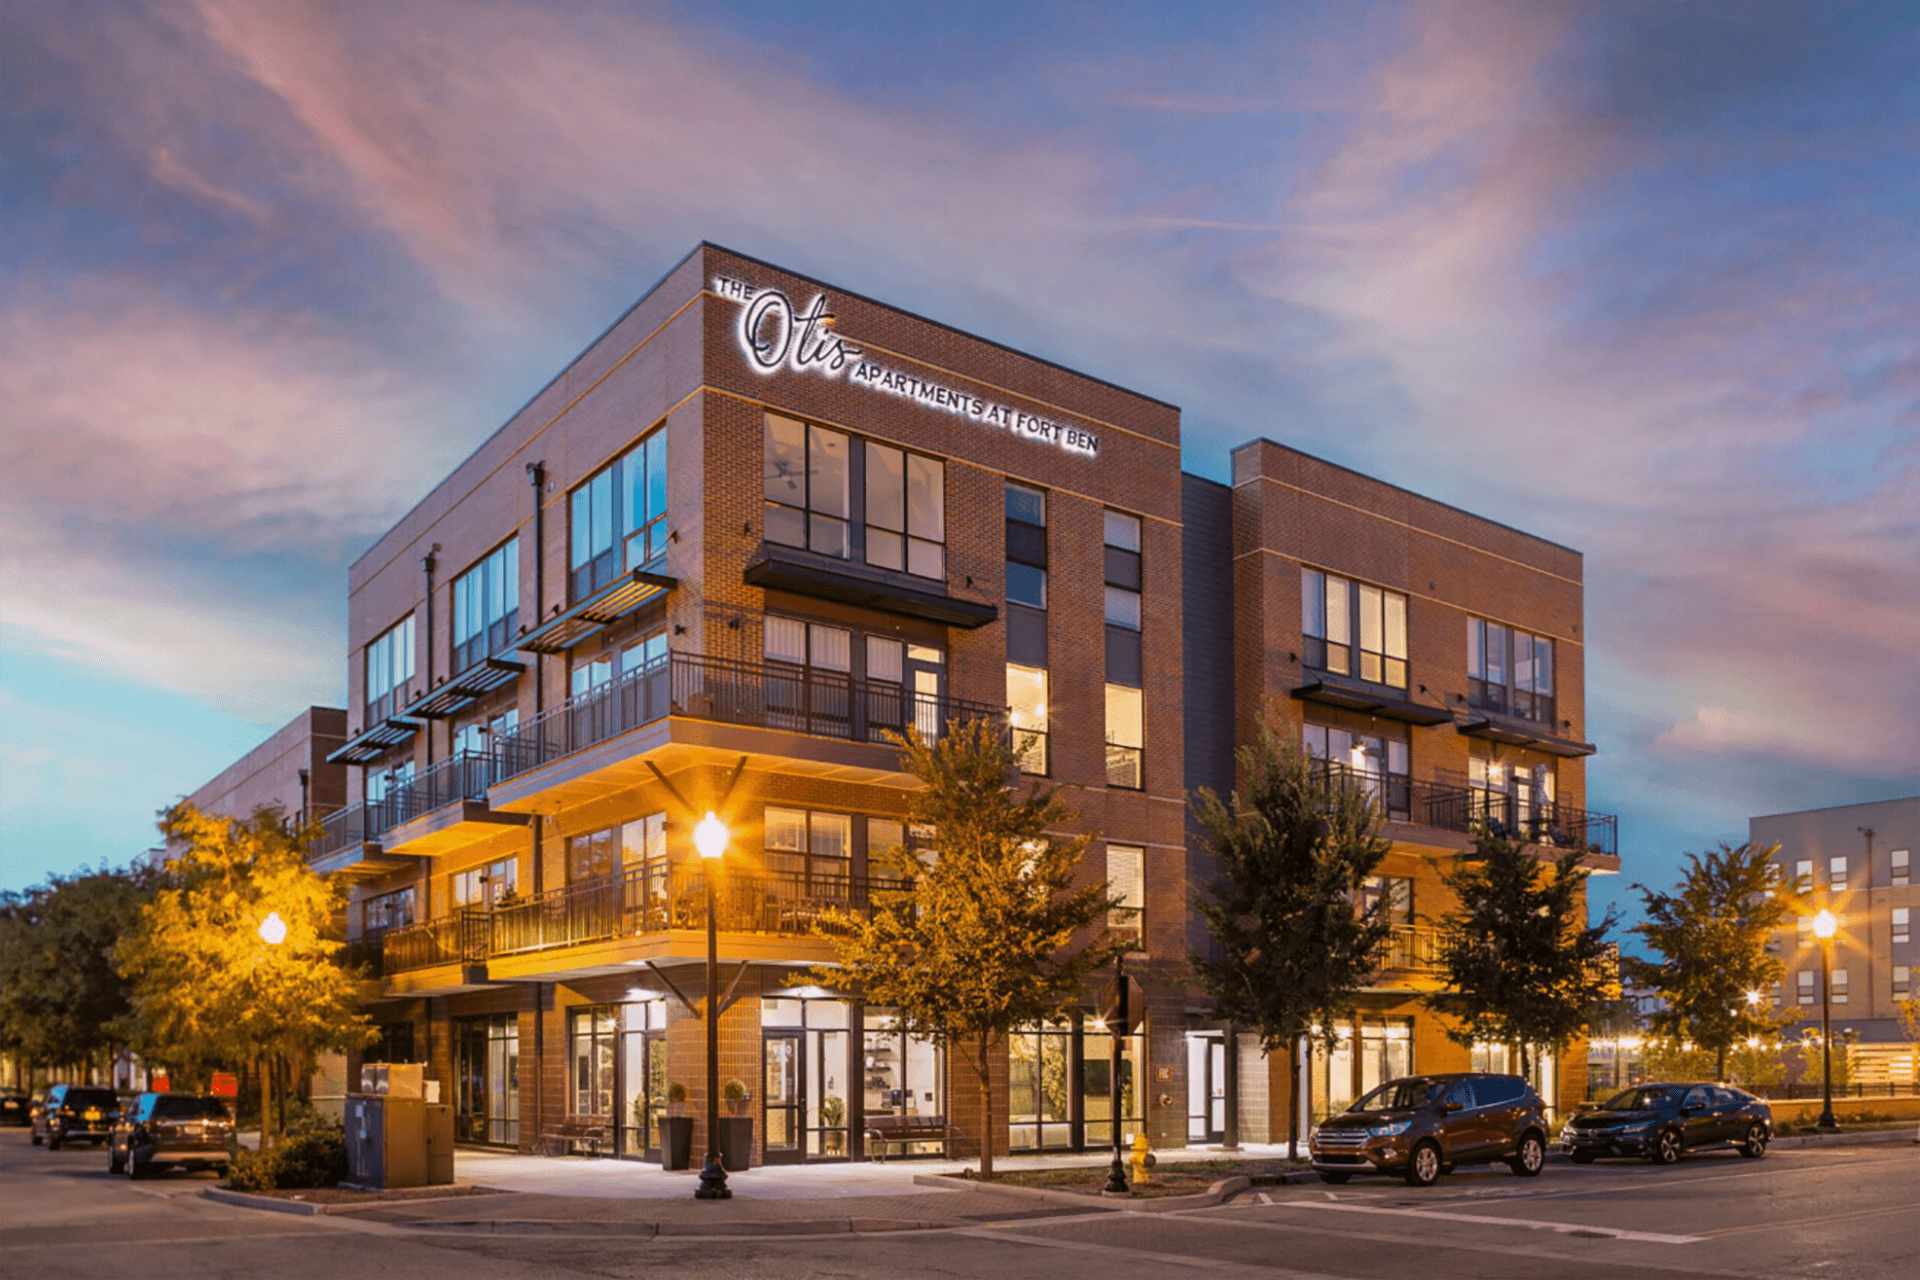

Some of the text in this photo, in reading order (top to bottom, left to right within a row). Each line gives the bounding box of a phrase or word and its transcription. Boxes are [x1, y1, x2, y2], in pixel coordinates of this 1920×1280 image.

[717, 276, 757, 300] THE
[745, 291, 862, 370] Otis
[855, 362, 1099, 452] APARTMENTS AT FORT BEN
